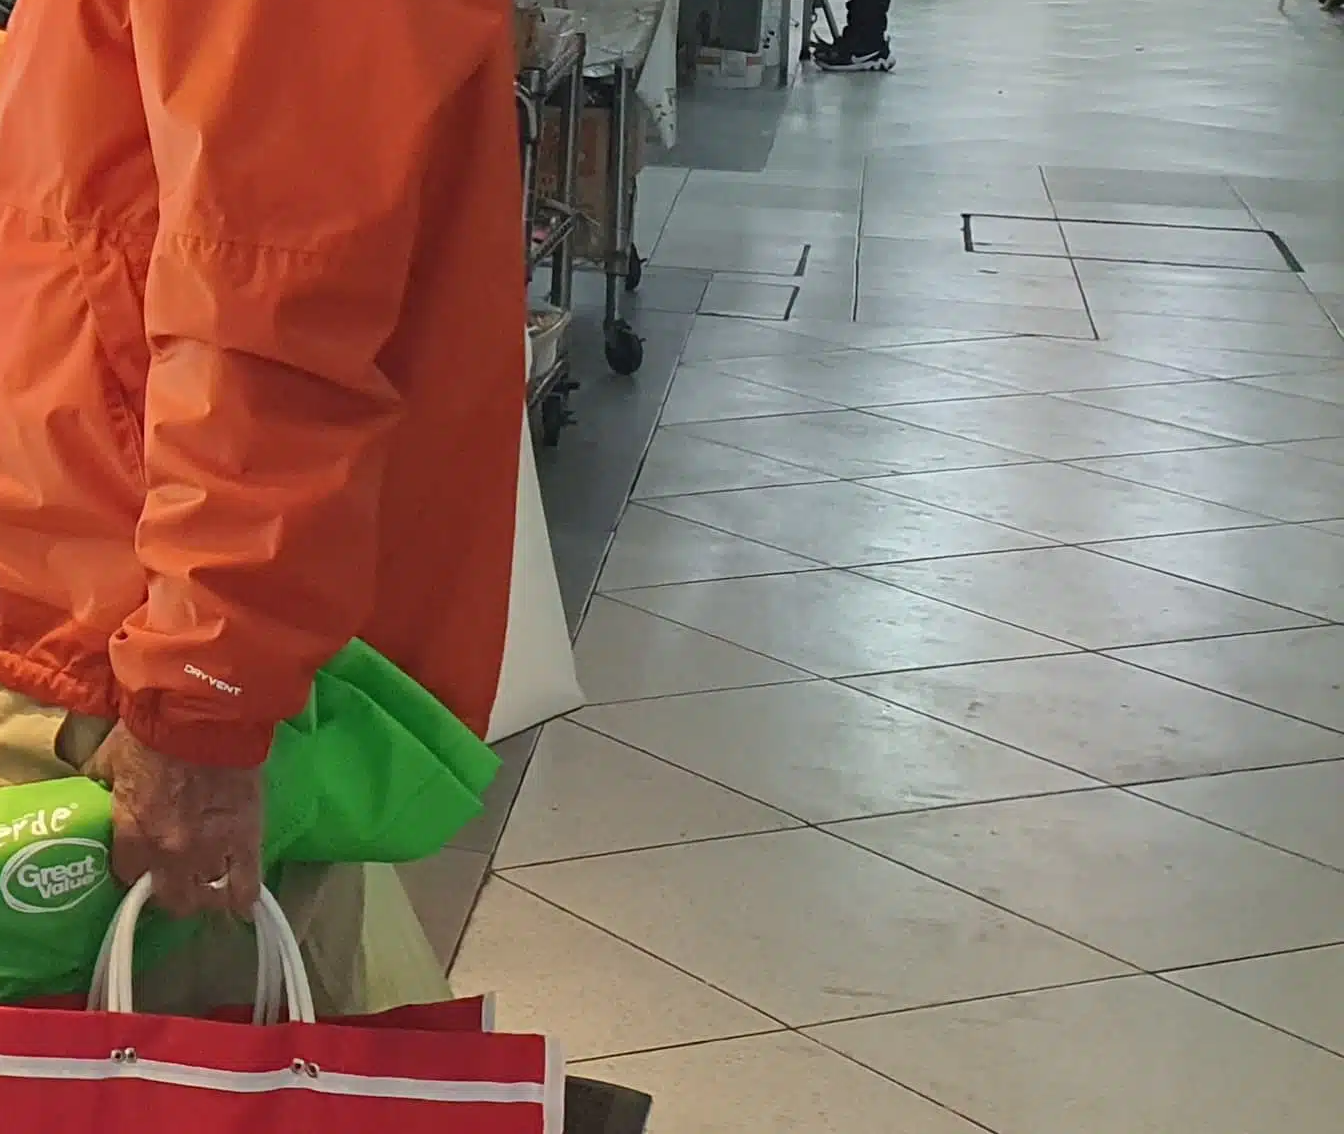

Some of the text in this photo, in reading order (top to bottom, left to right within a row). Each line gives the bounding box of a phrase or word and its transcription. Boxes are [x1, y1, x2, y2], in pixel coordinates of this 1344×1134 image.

[183, 663, 243, 697] DRYVENT
[16, 854, 96, 888] Great
[37, 873, 97, 900] Value
